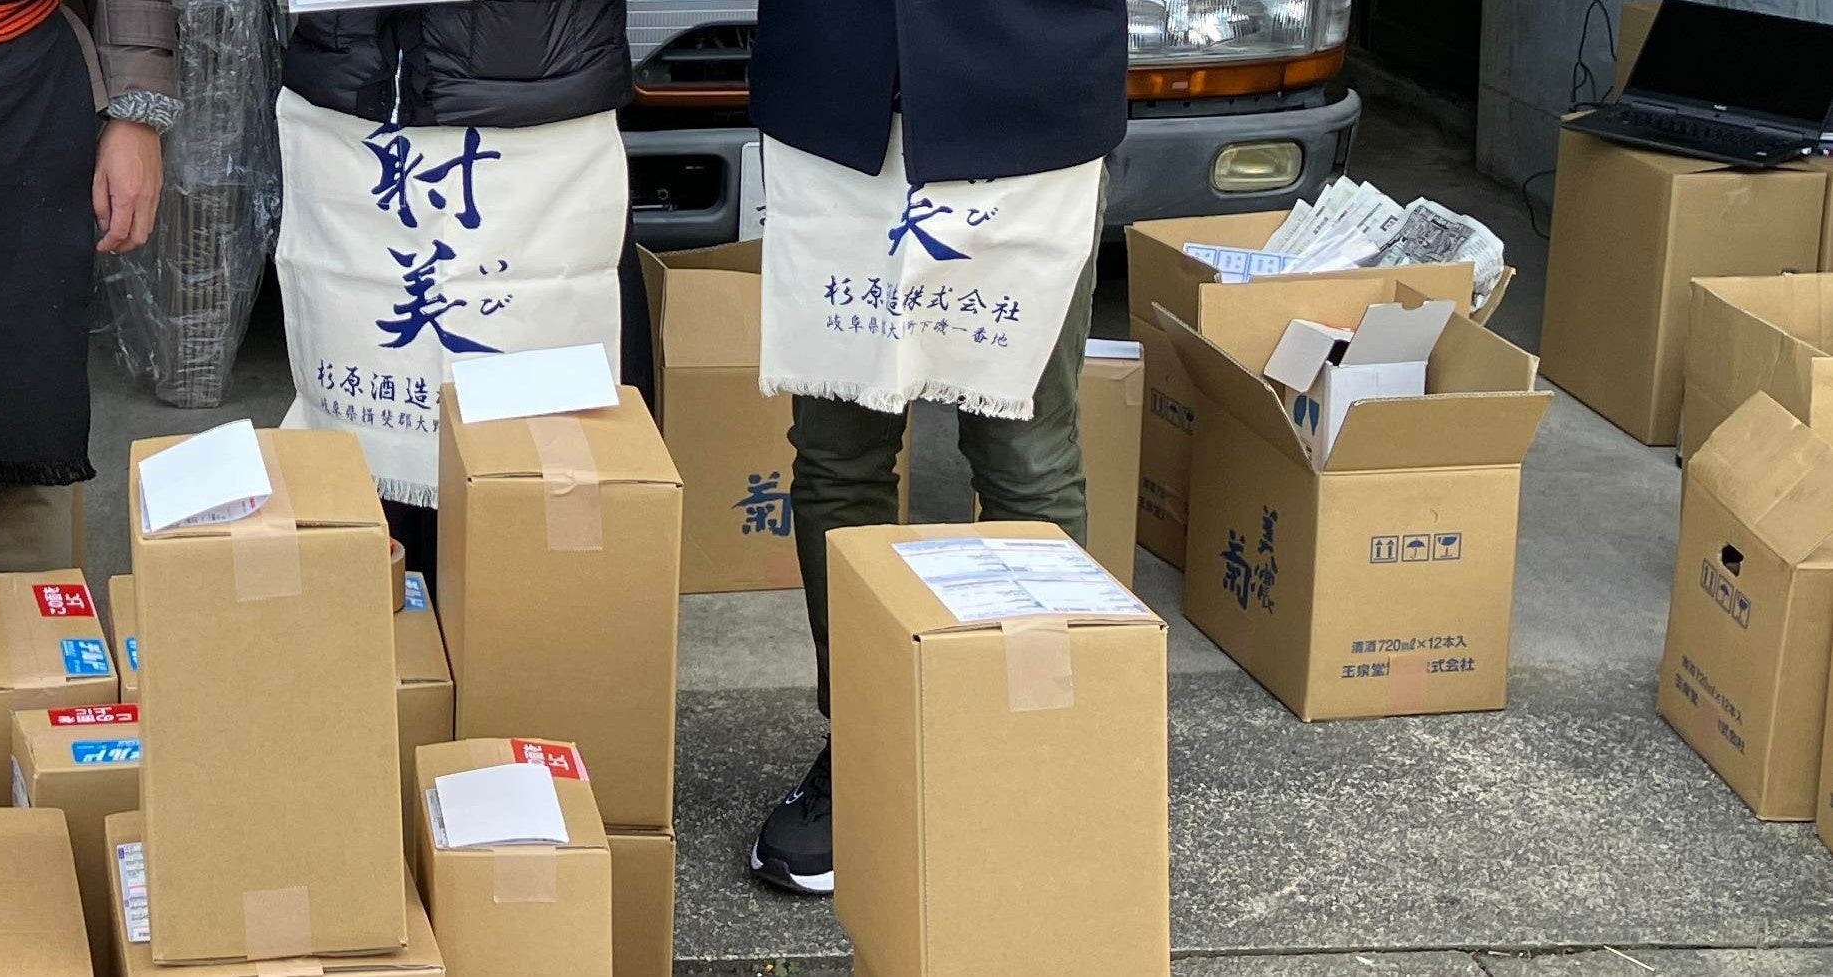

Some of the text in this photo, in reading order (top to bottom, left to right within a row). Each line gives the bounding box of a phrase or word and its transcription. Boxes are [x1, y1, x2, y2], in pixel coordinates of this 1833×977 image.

[362, 121, 505, 353] 射美
[479, 259, 513, 316] いび
[824, 275, 1021, 323] 杉原造株式会社
[317, 360, 440, 410] 杉原酒造
[731, 471, 791, 537] 菊
[79, 641, 108, 671] チルド
